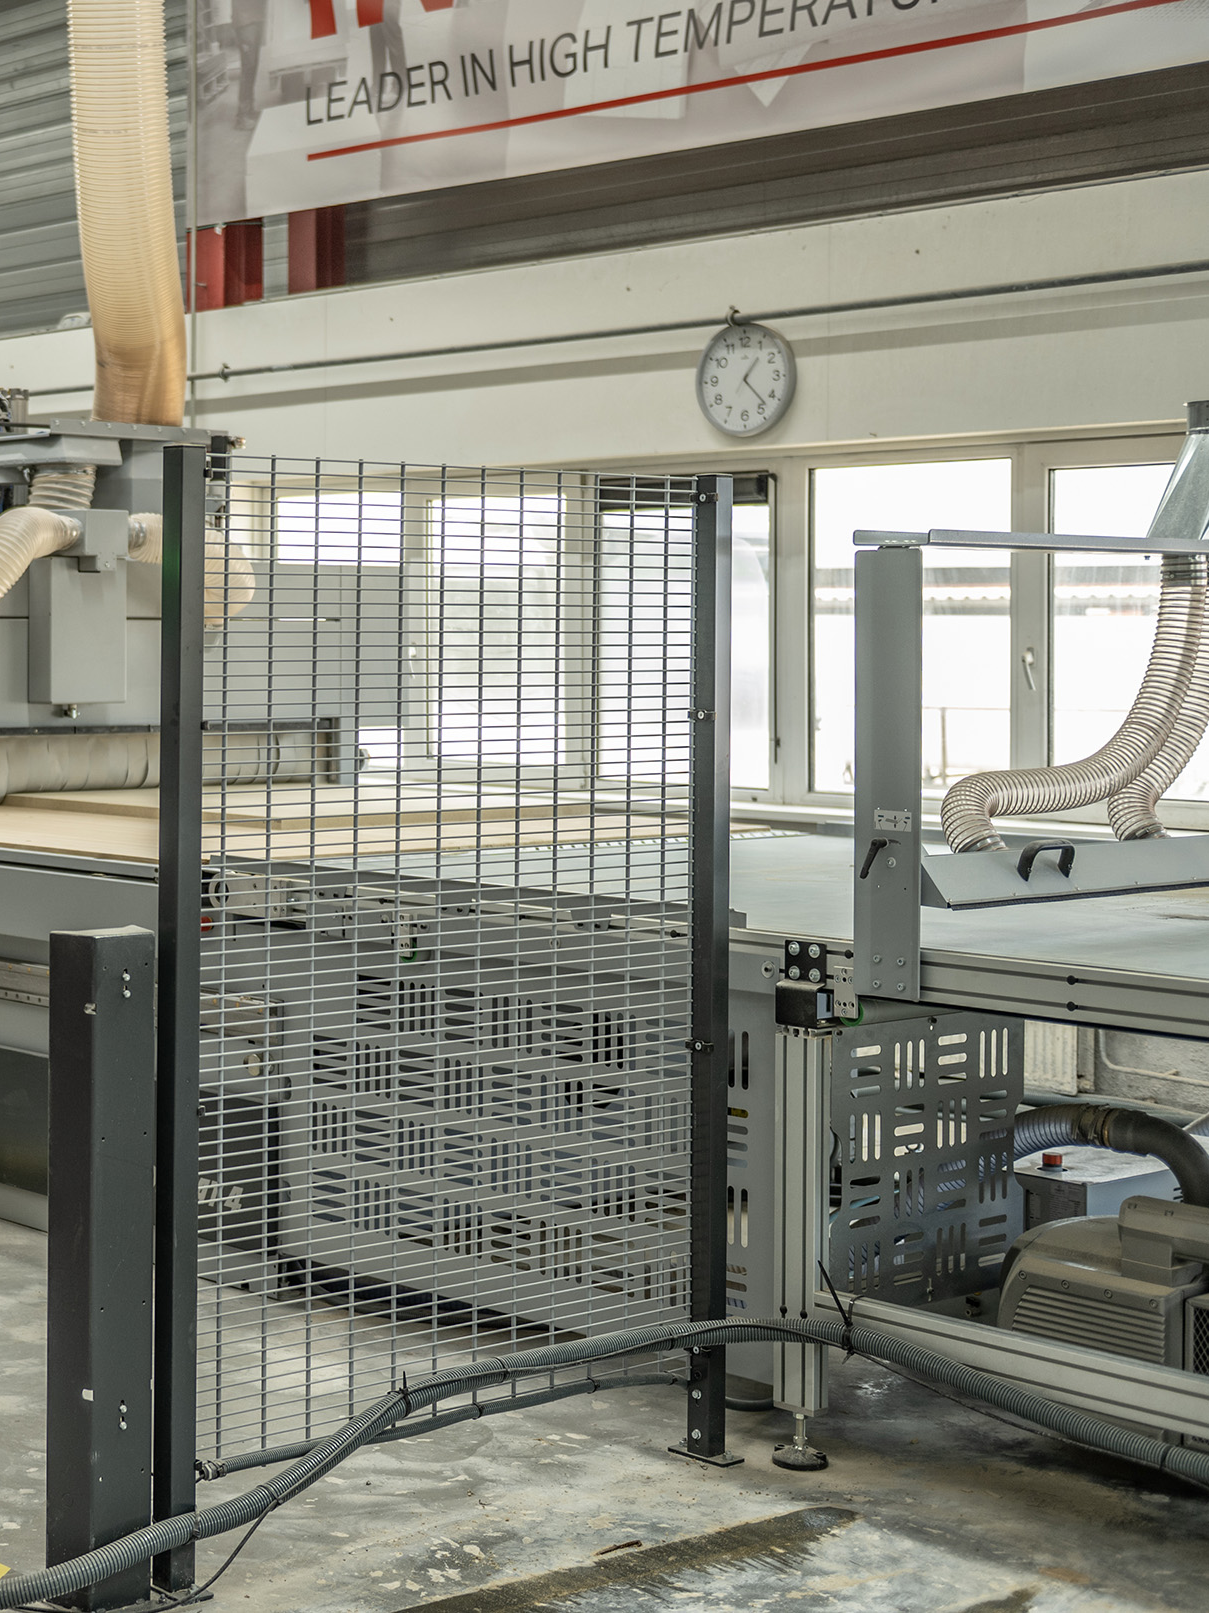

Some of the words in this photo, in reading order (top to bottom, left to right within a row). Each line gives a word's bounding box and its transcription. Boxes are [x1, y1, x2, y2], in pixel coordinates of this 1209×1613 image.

[304, 60, 453, 126] LEADER
[460, 48, 497, 98] IN
[508, 25, 612, 88] HIGH
[626, 0, 939, 63] TEMPERA
[739, 336, 751, 348] 12
[726, 343, 735, 354] 11
[715, 357, 728, 369] 10
[767, 352, 776, 364] 2
[710, 375, 719, 387] 9
[772, 369, 781, 381] 3
[714, 393, 723, 406] 8
[768, 389, 776, 400] 4
[725, 405, 733, 417] 7
[757, 403, 766, 415] 5
[740, 410, 750, 422] 6
